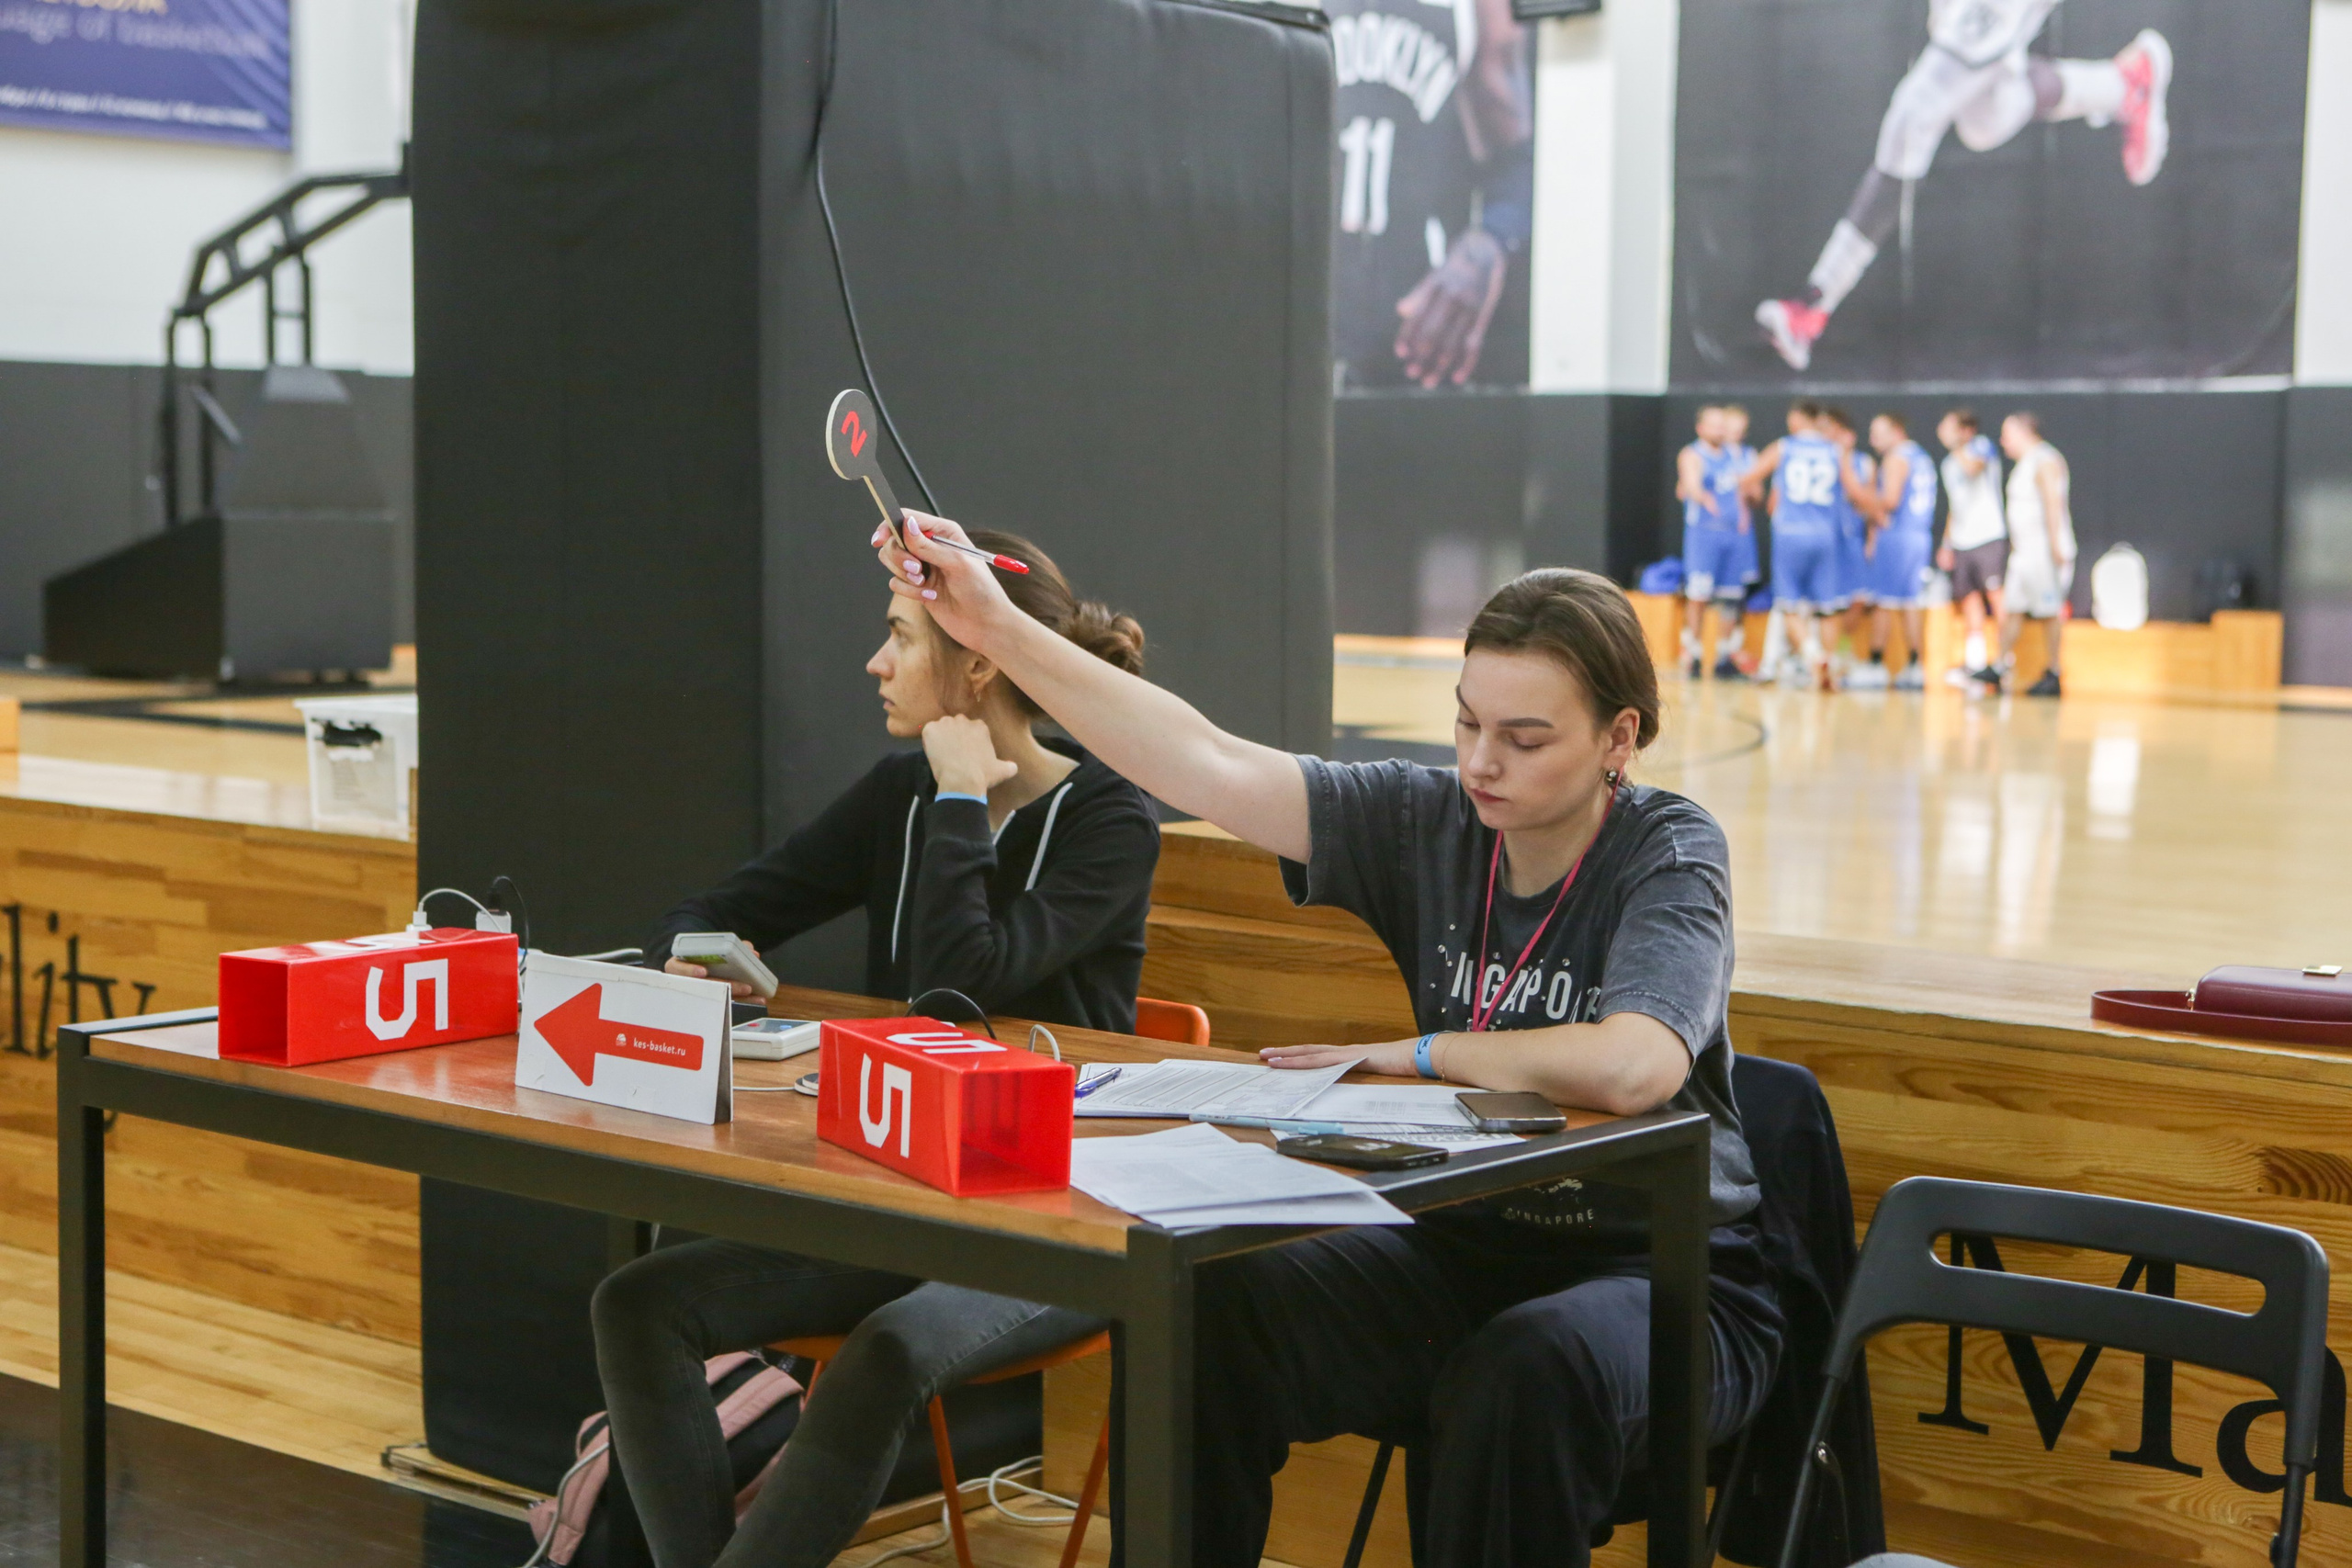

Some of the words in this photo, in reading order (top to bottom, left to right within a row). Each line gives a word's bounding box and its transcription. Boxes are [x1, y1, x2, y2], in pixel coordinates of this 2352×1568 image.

[1339, 116, 1395, 235] 11
[841, 411, 867, 457] 2
[1784, 460, 1836, 506] 92
[366, 958, 448, 1041] 5
[633, 1037, 686, 1056] kes-basket.ru
[886, 1032, 1008, 1055] 5
[859, 1053, 911, 1158] 5
